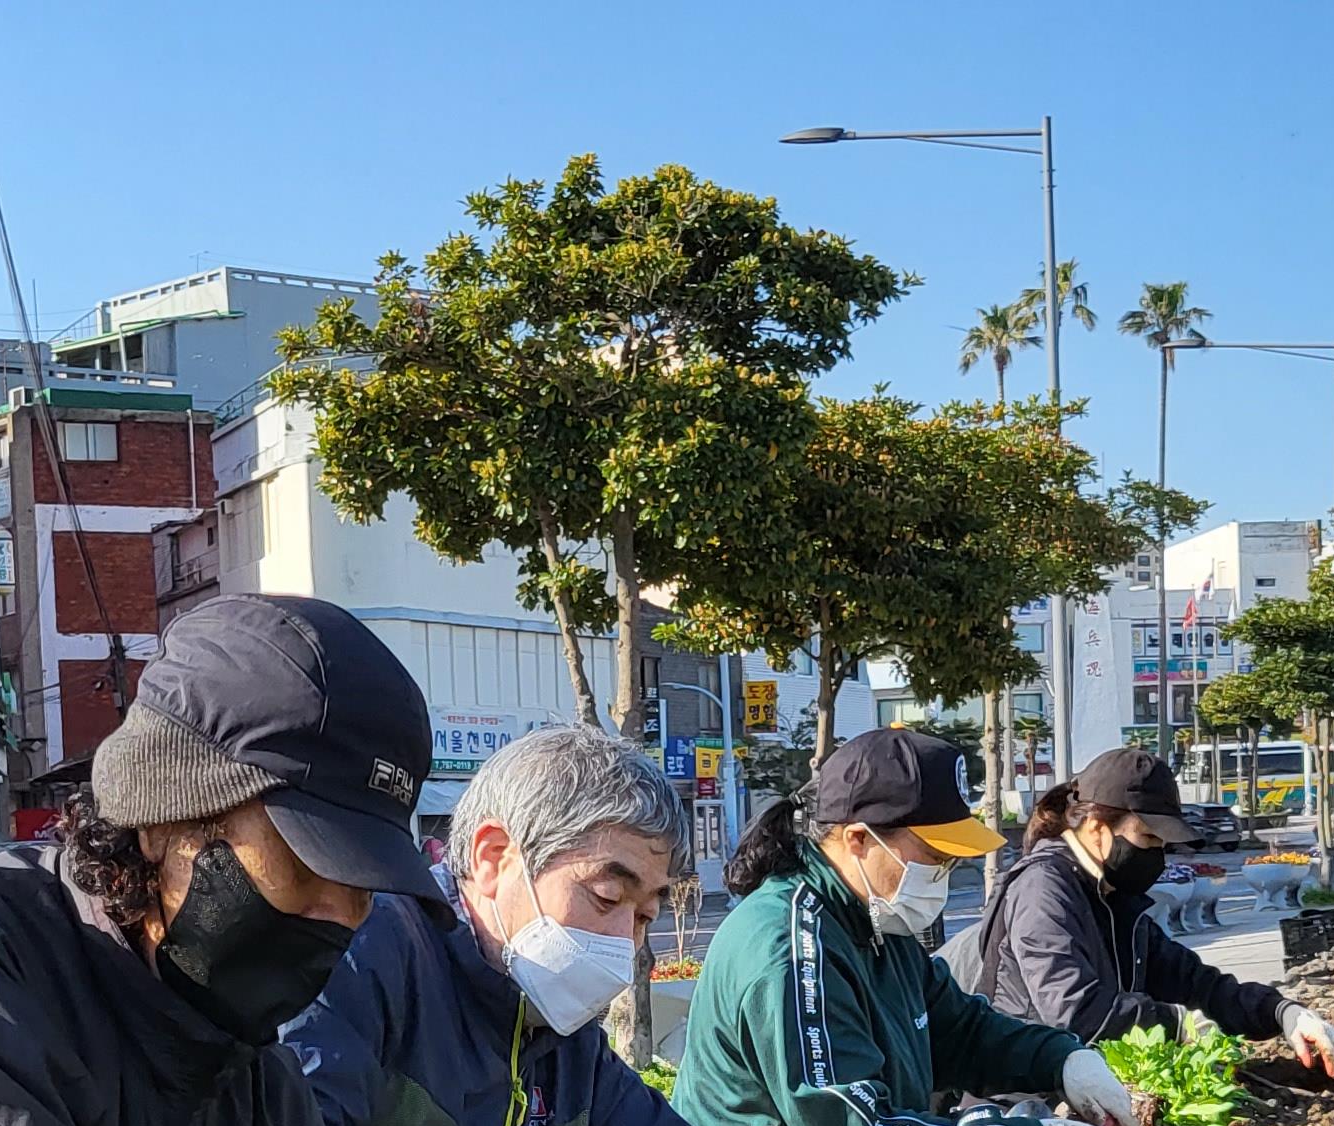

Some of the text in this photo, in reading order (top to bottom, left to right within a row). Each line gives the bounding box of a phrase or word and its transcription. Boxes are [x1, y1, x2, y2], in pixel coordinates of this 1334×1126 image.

[747, 683, 775, 701] 도장
[395, 768, 414, 794] FILA
[800, 960, 817, 1015] Equipment
[806, 1026, 822, 1060] Sports
